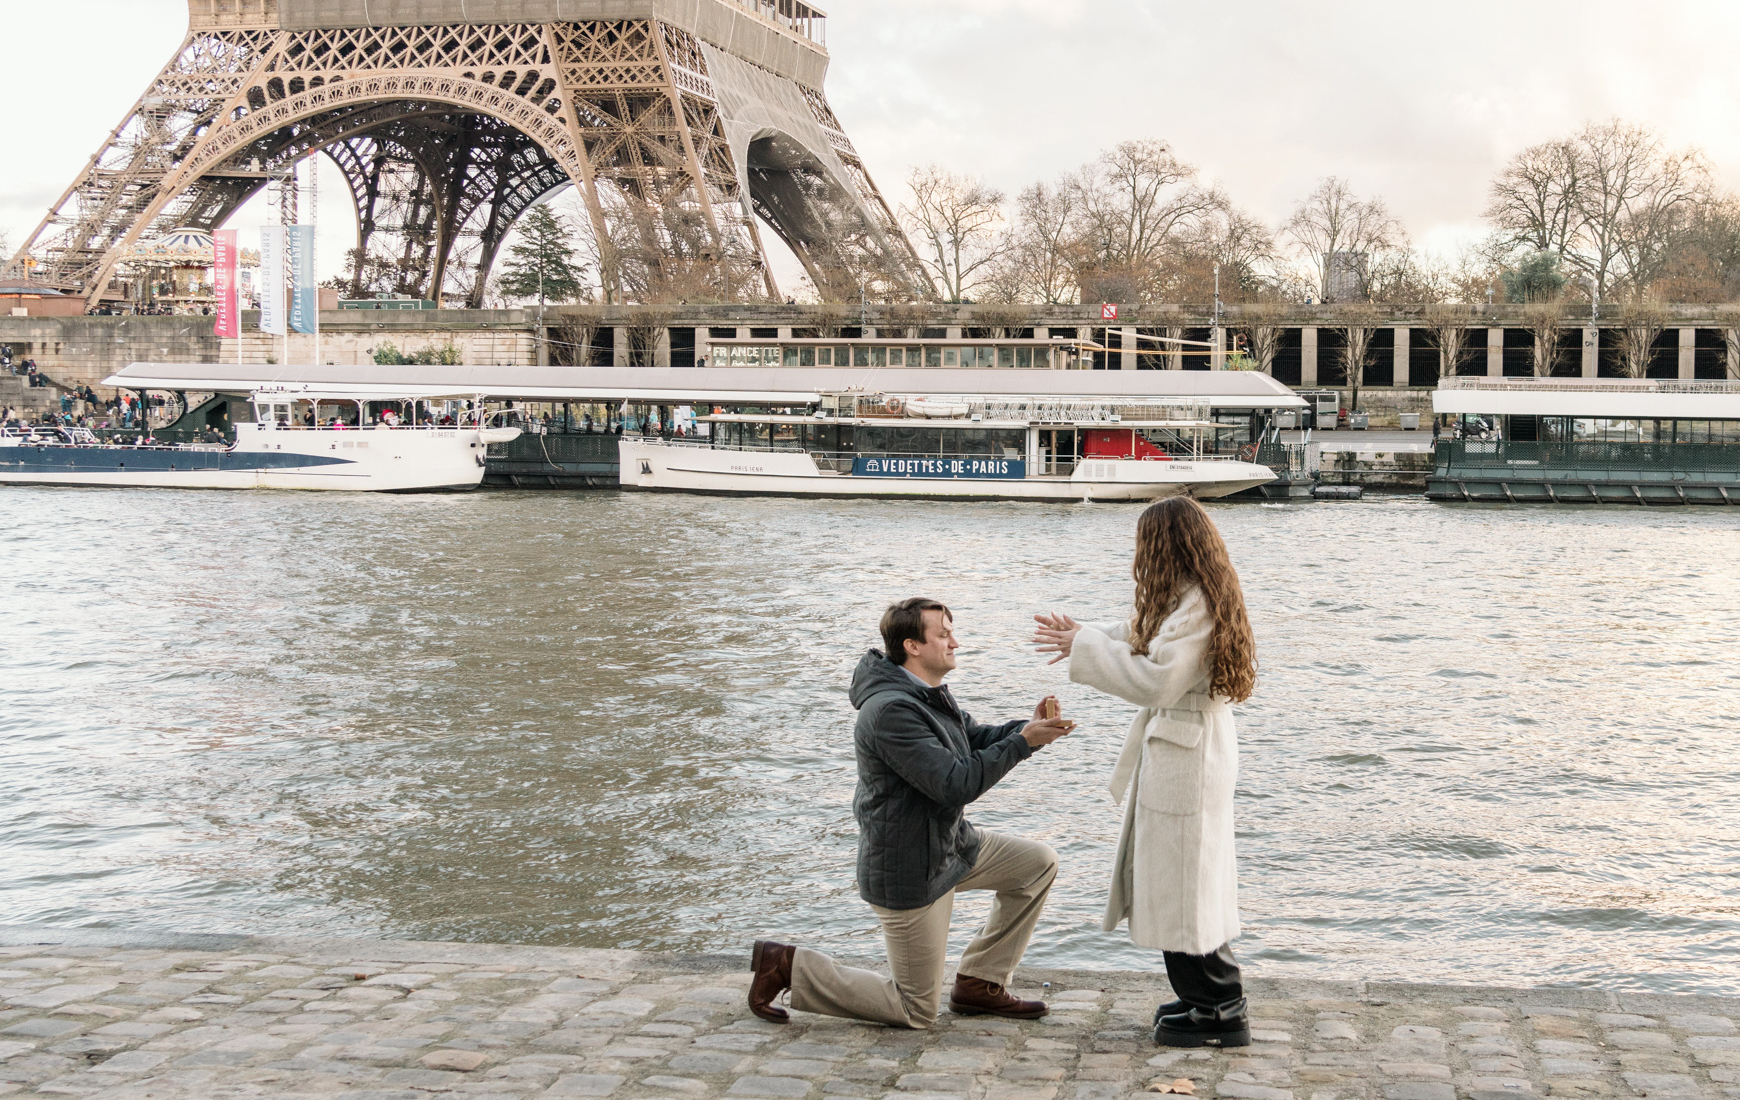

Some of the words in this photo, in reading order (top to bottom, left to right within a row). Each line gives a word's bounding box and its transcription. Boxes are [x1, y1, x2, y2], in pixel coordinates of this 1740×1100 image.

[881, 459, 943, 473] VEDETTES
[951, 460, 964, 474] DE
[972, 461, 1008, 474] PARIS
